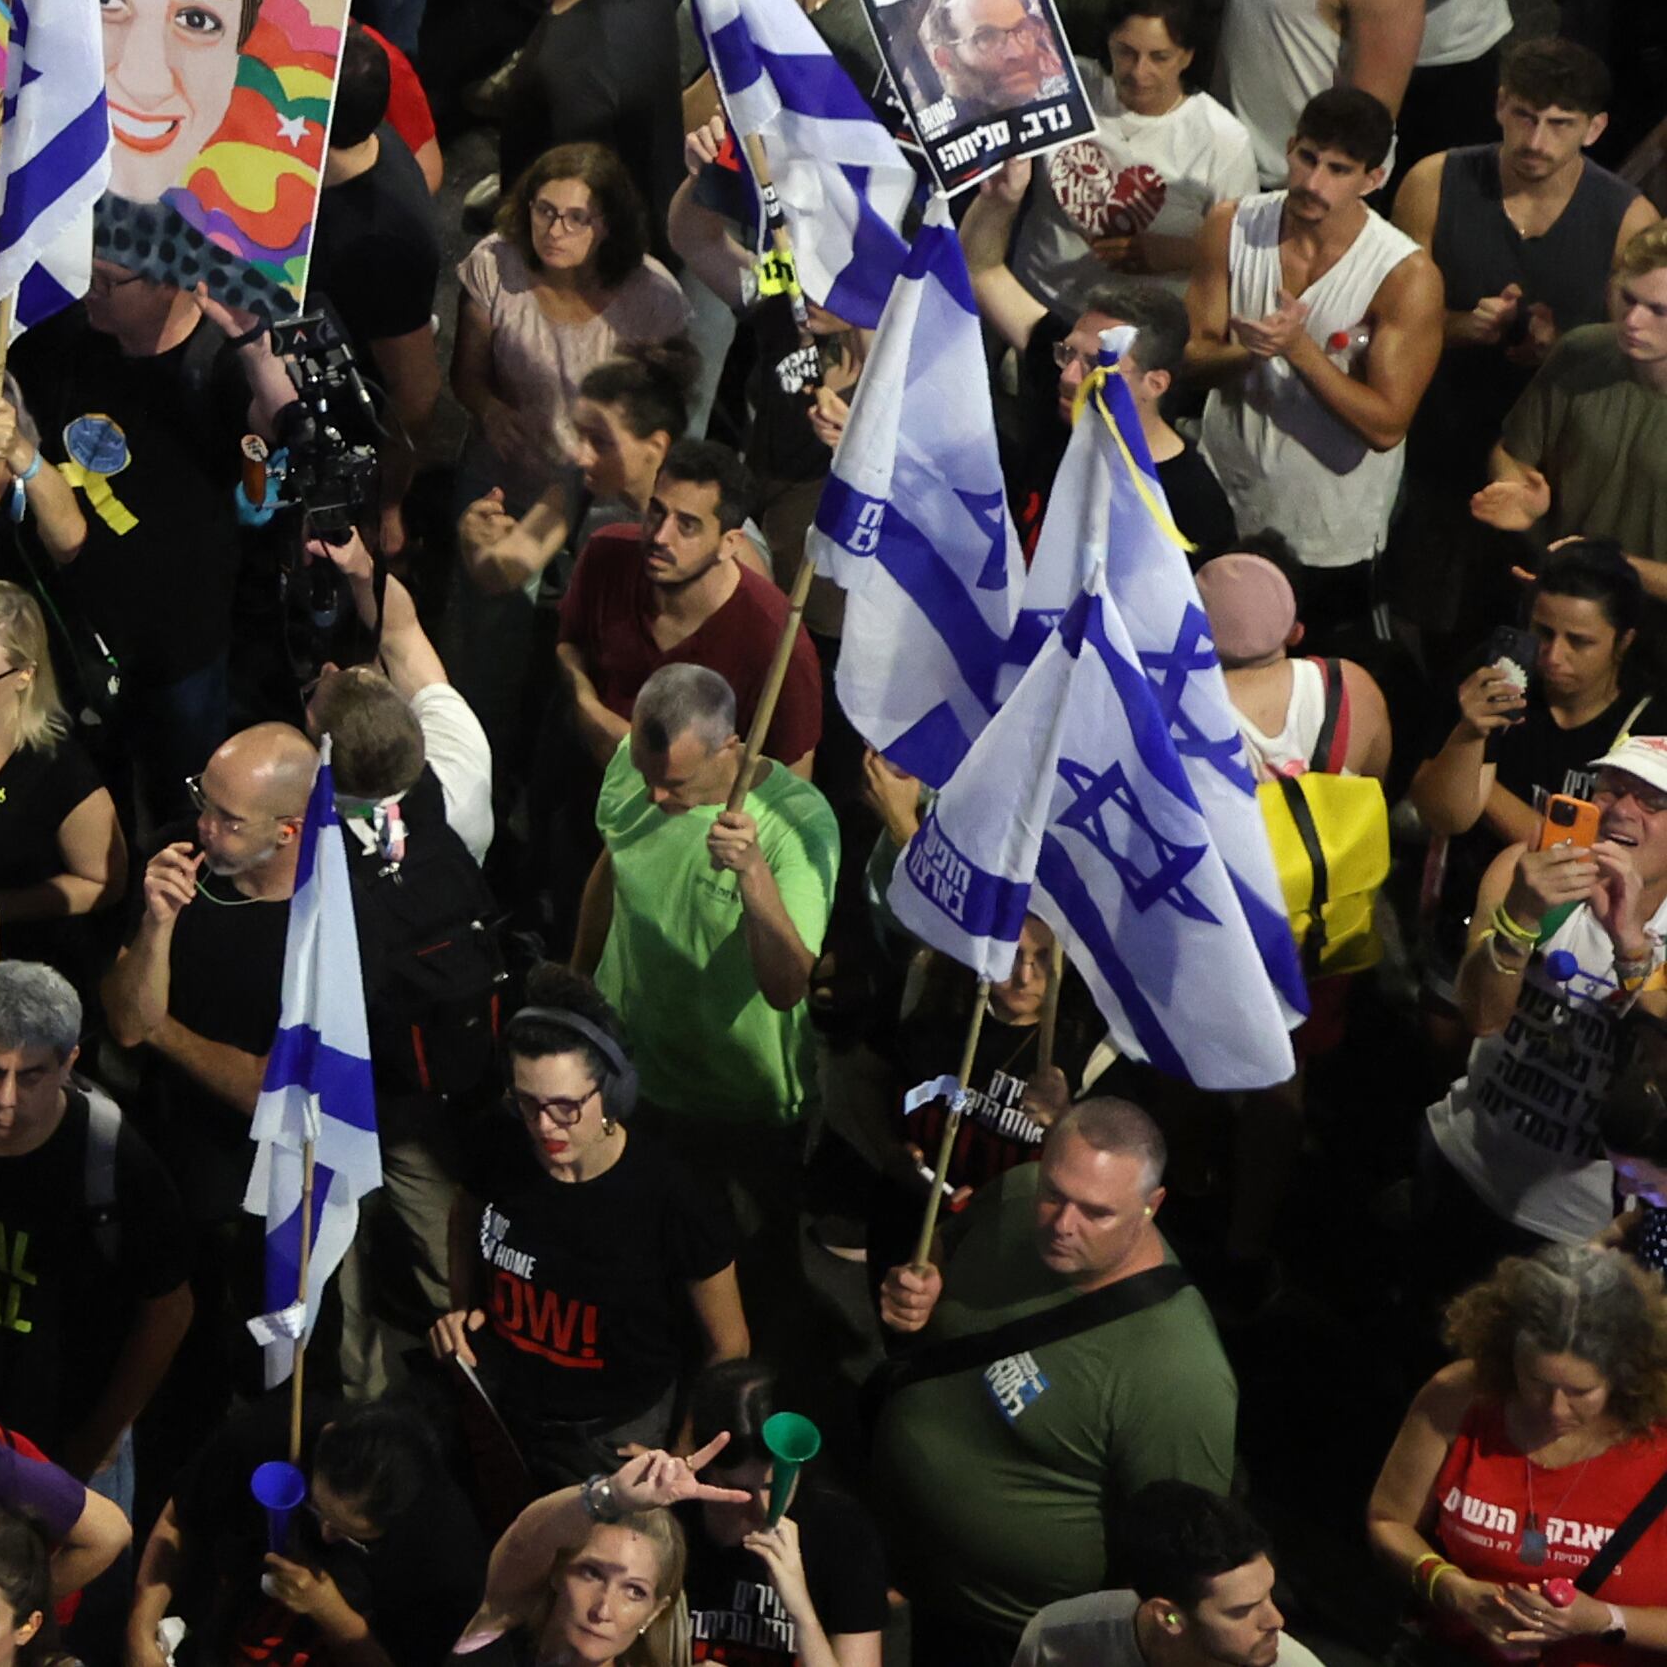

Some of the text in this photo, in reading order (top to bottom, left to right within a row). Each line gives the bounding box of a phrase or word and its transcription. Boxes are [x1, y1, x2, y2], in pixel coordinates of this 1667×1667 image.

[937, 103, 1074, 172] נדב, סליחה!
[491, 1243, 537, 1281] HOME
